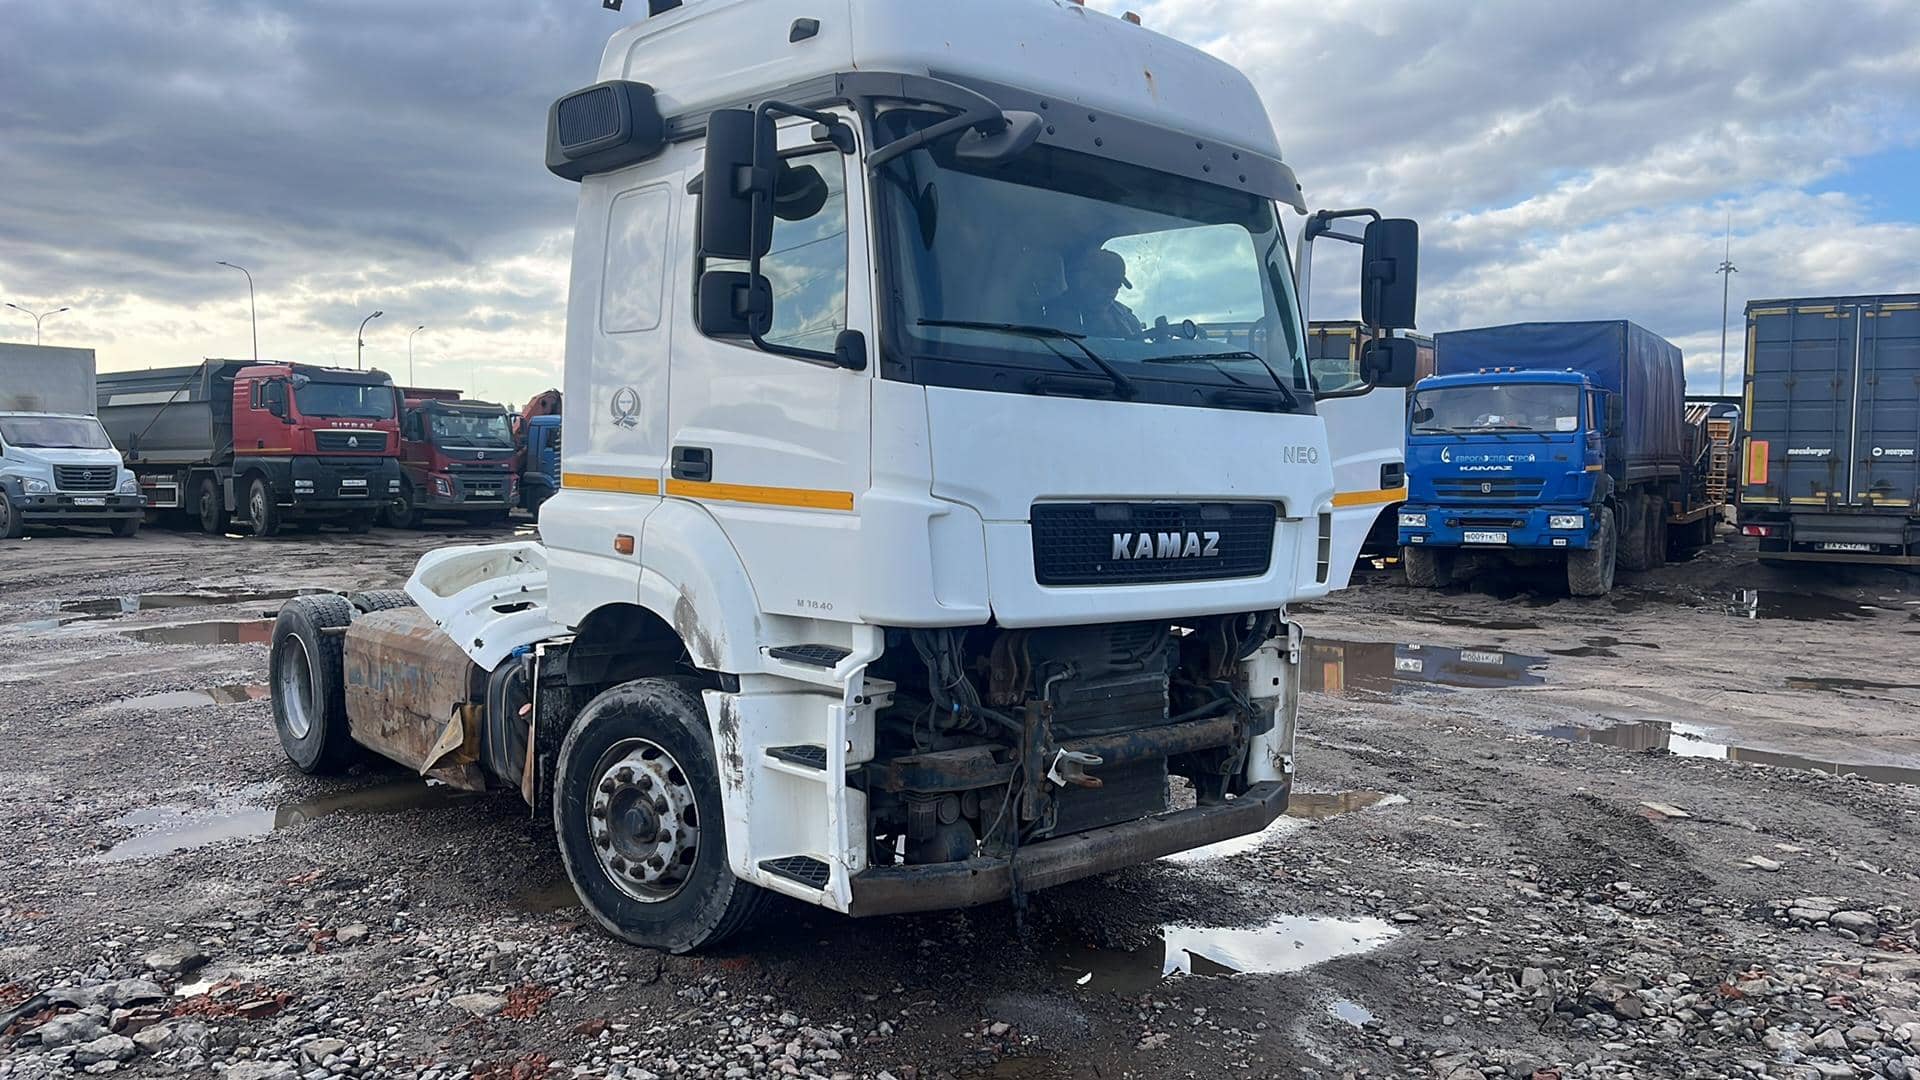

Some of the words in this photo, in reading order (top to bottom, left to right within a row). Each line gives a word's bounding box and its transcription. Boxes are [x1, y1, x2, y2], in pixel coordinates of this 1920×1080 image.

[1283, 445, 1319, 465] NEO
[1112, 531, 1220, 560] KAMAZ
[797, 599, 804, 607] M
